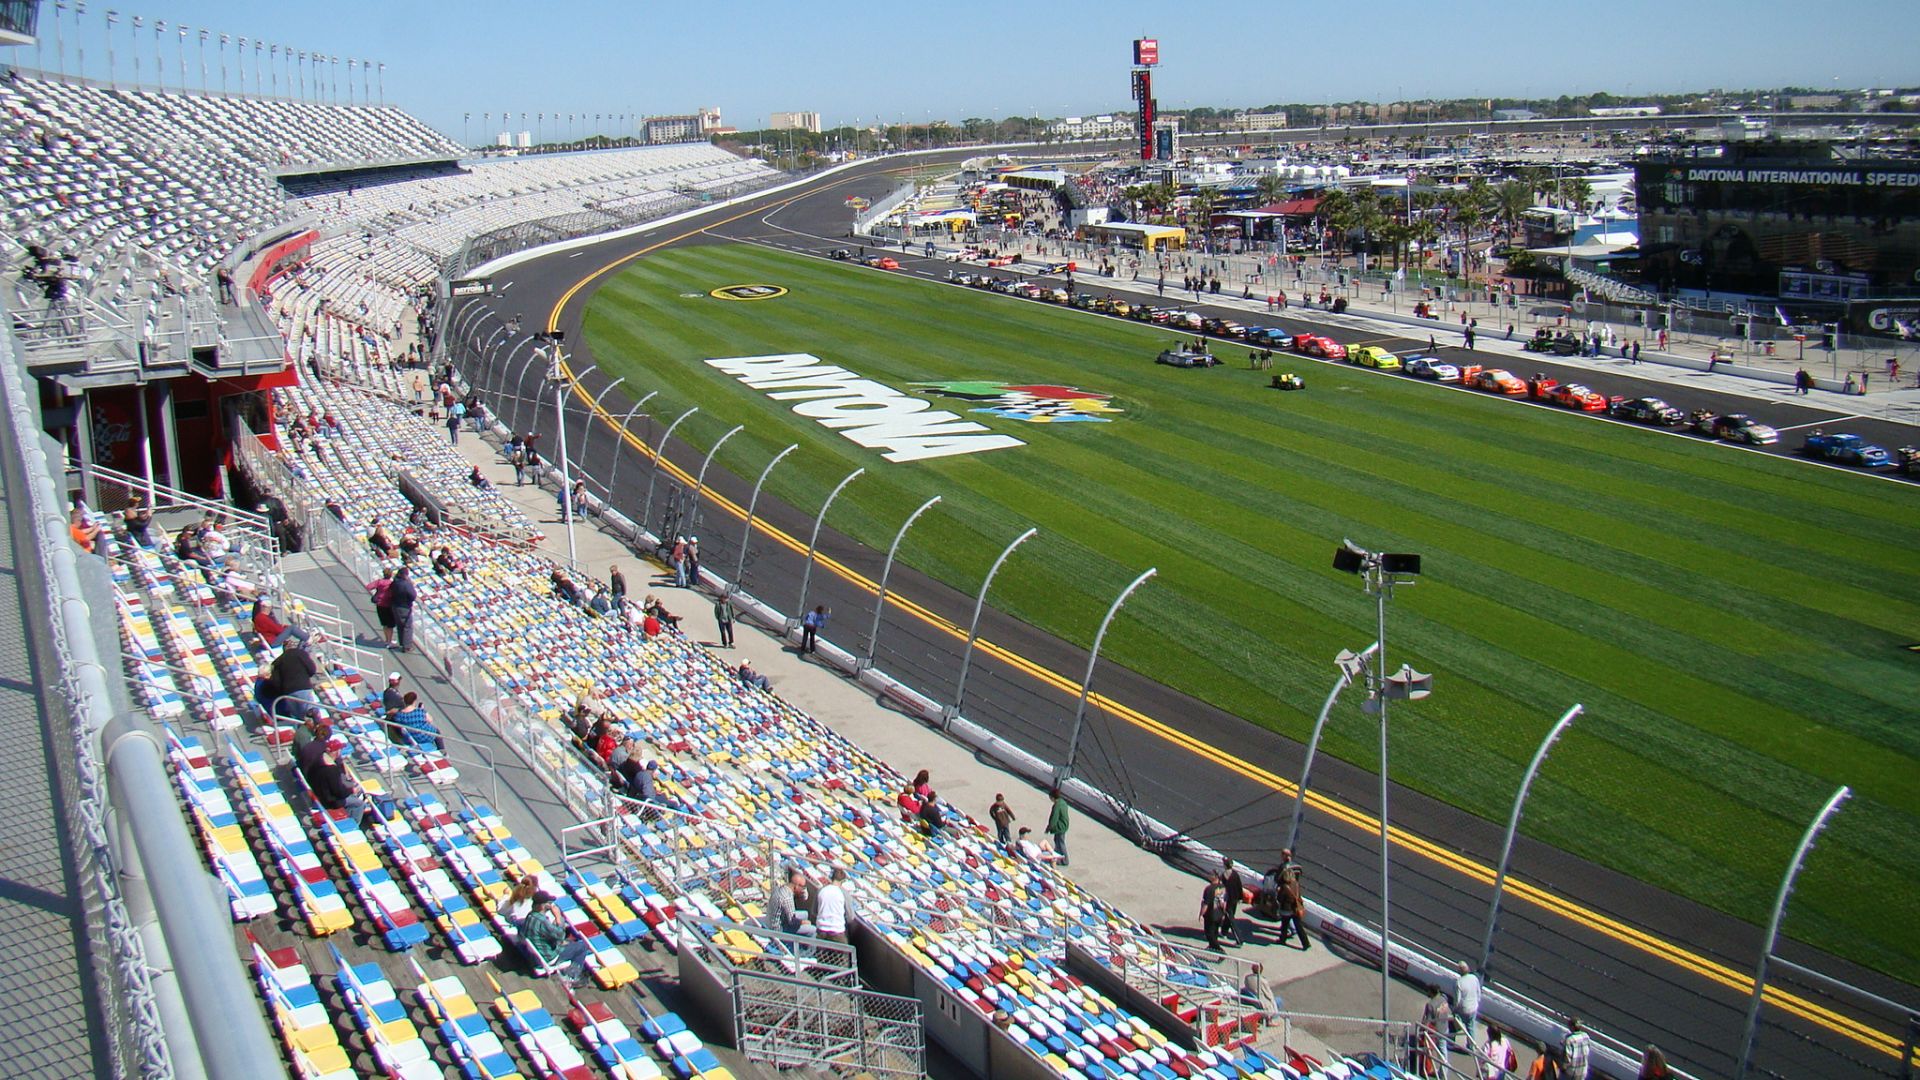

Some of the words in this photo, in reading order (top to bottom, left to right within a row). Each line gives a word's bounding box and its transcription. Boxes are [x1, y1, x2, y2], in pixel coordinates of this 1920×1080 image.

[1688, 169, 1744, 183] DAYTONA
[1747, 170, 1861, 185] INTERNATIONAL
[1865, 172, 1920, 187] SPEED
[704, 354, 1027, 463] DAYTONA
